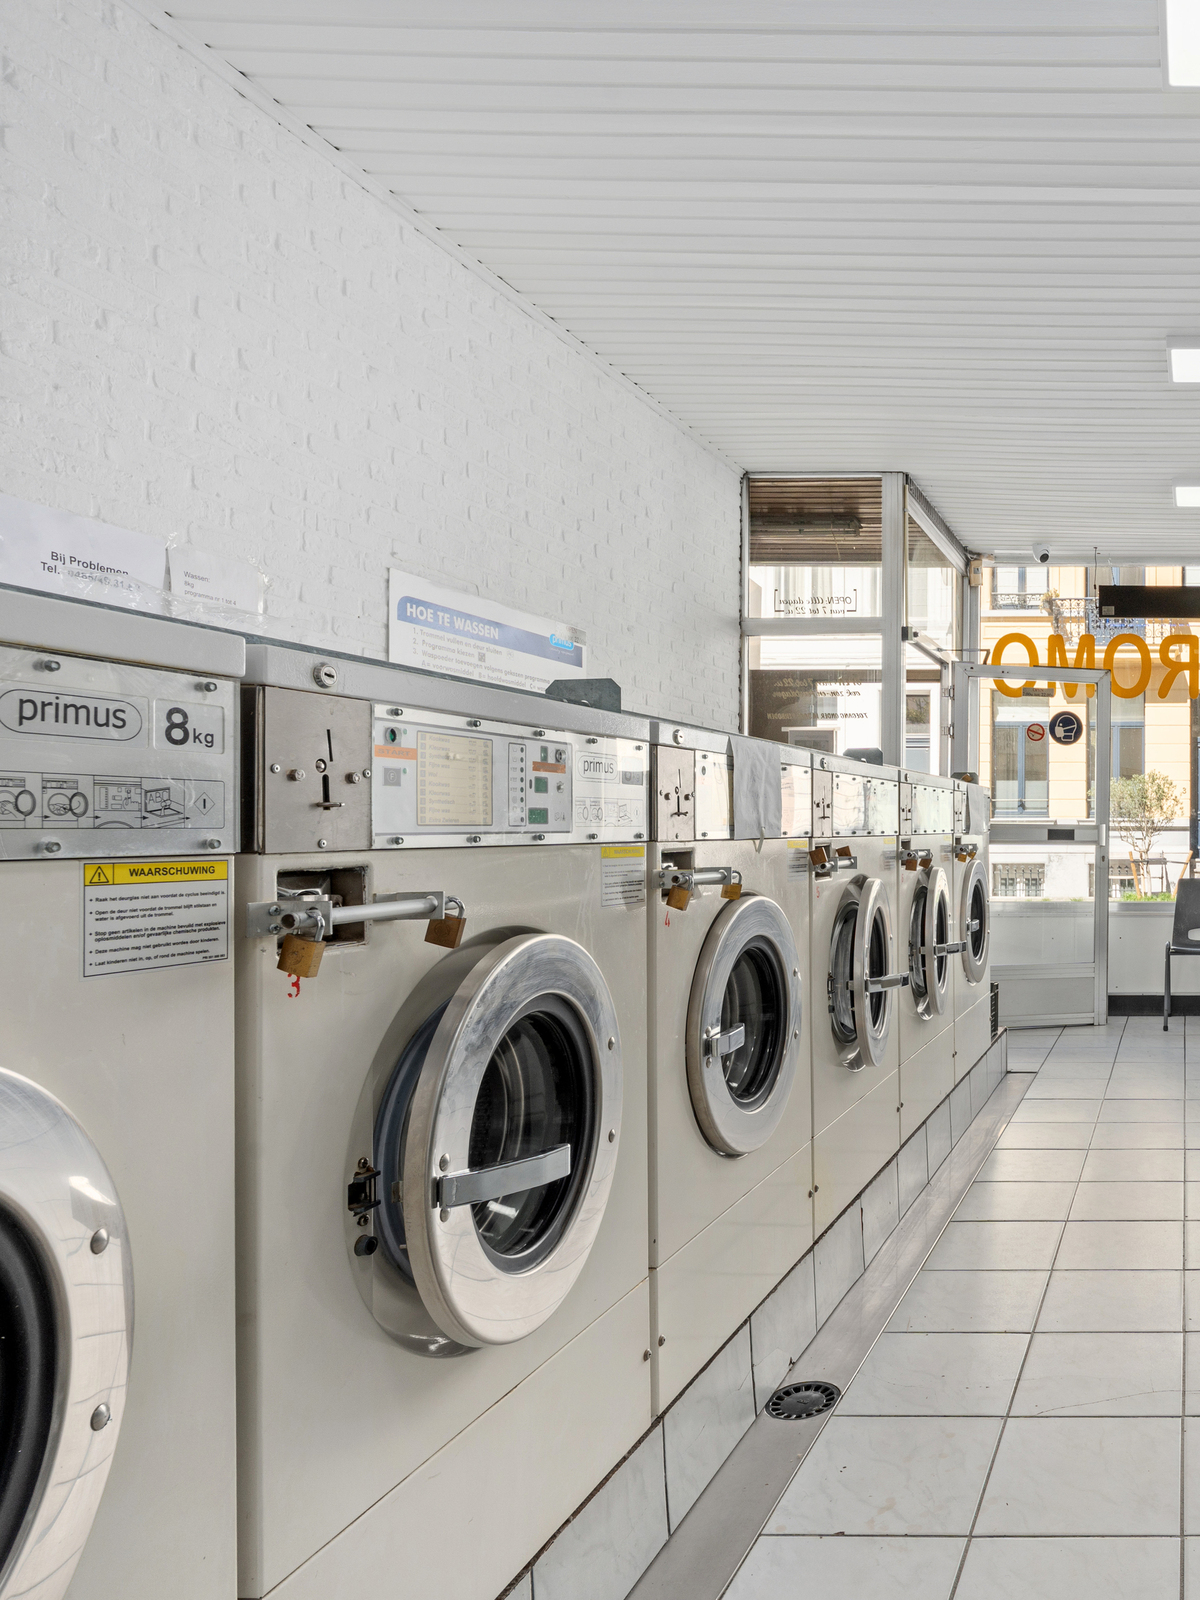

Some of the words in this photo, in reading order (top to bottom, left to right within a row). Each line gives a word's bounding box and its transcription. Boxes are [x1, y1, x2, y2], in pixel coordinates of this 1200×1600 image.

[50, 551, 66, 565] Bij
[41, 561, 60, 575] Tel.
[183, 571, 211, 583] Wassen:
[184, 589, 213, 600] programma
[406, 602, 434, 623] HOE
[437, 612, 450, 627] TE
[453, 616, 499, 640] WASSEN
[420, 629, 445, 642] Trommel
[446, 636, 463, 646] vullen
[472, 642, 485, 652] deur
[486, 646, 503, 656] sluiten
[422, 640, 456, 654] Programma
[457, 648, 475, 658] kiezen
[421, 650, 454, 663] Waspoeder
[455, 658, 483, 670] toevoegen
[484, 664, 503, 675] volgens
[504, 669, 524, 678] gekozen
[524, 674, 550, 684] programma
[432, 662, 474, 677] voorwasmiddel
[487, 675, 526, 688] hoofdwasmiddel
[18, 696, 127, 729] primus
[378, 748, 411, 757] START
[583, 758, 614, 774] primus
[129, 866, 216, 877] WAARSCHUWING
[664, 911, 670, 927] 4
[94, 935, 132, 943] oplosmiddelen
[106, 957, 128, 965] kinderen
[287, 973, 300, 998] 3
